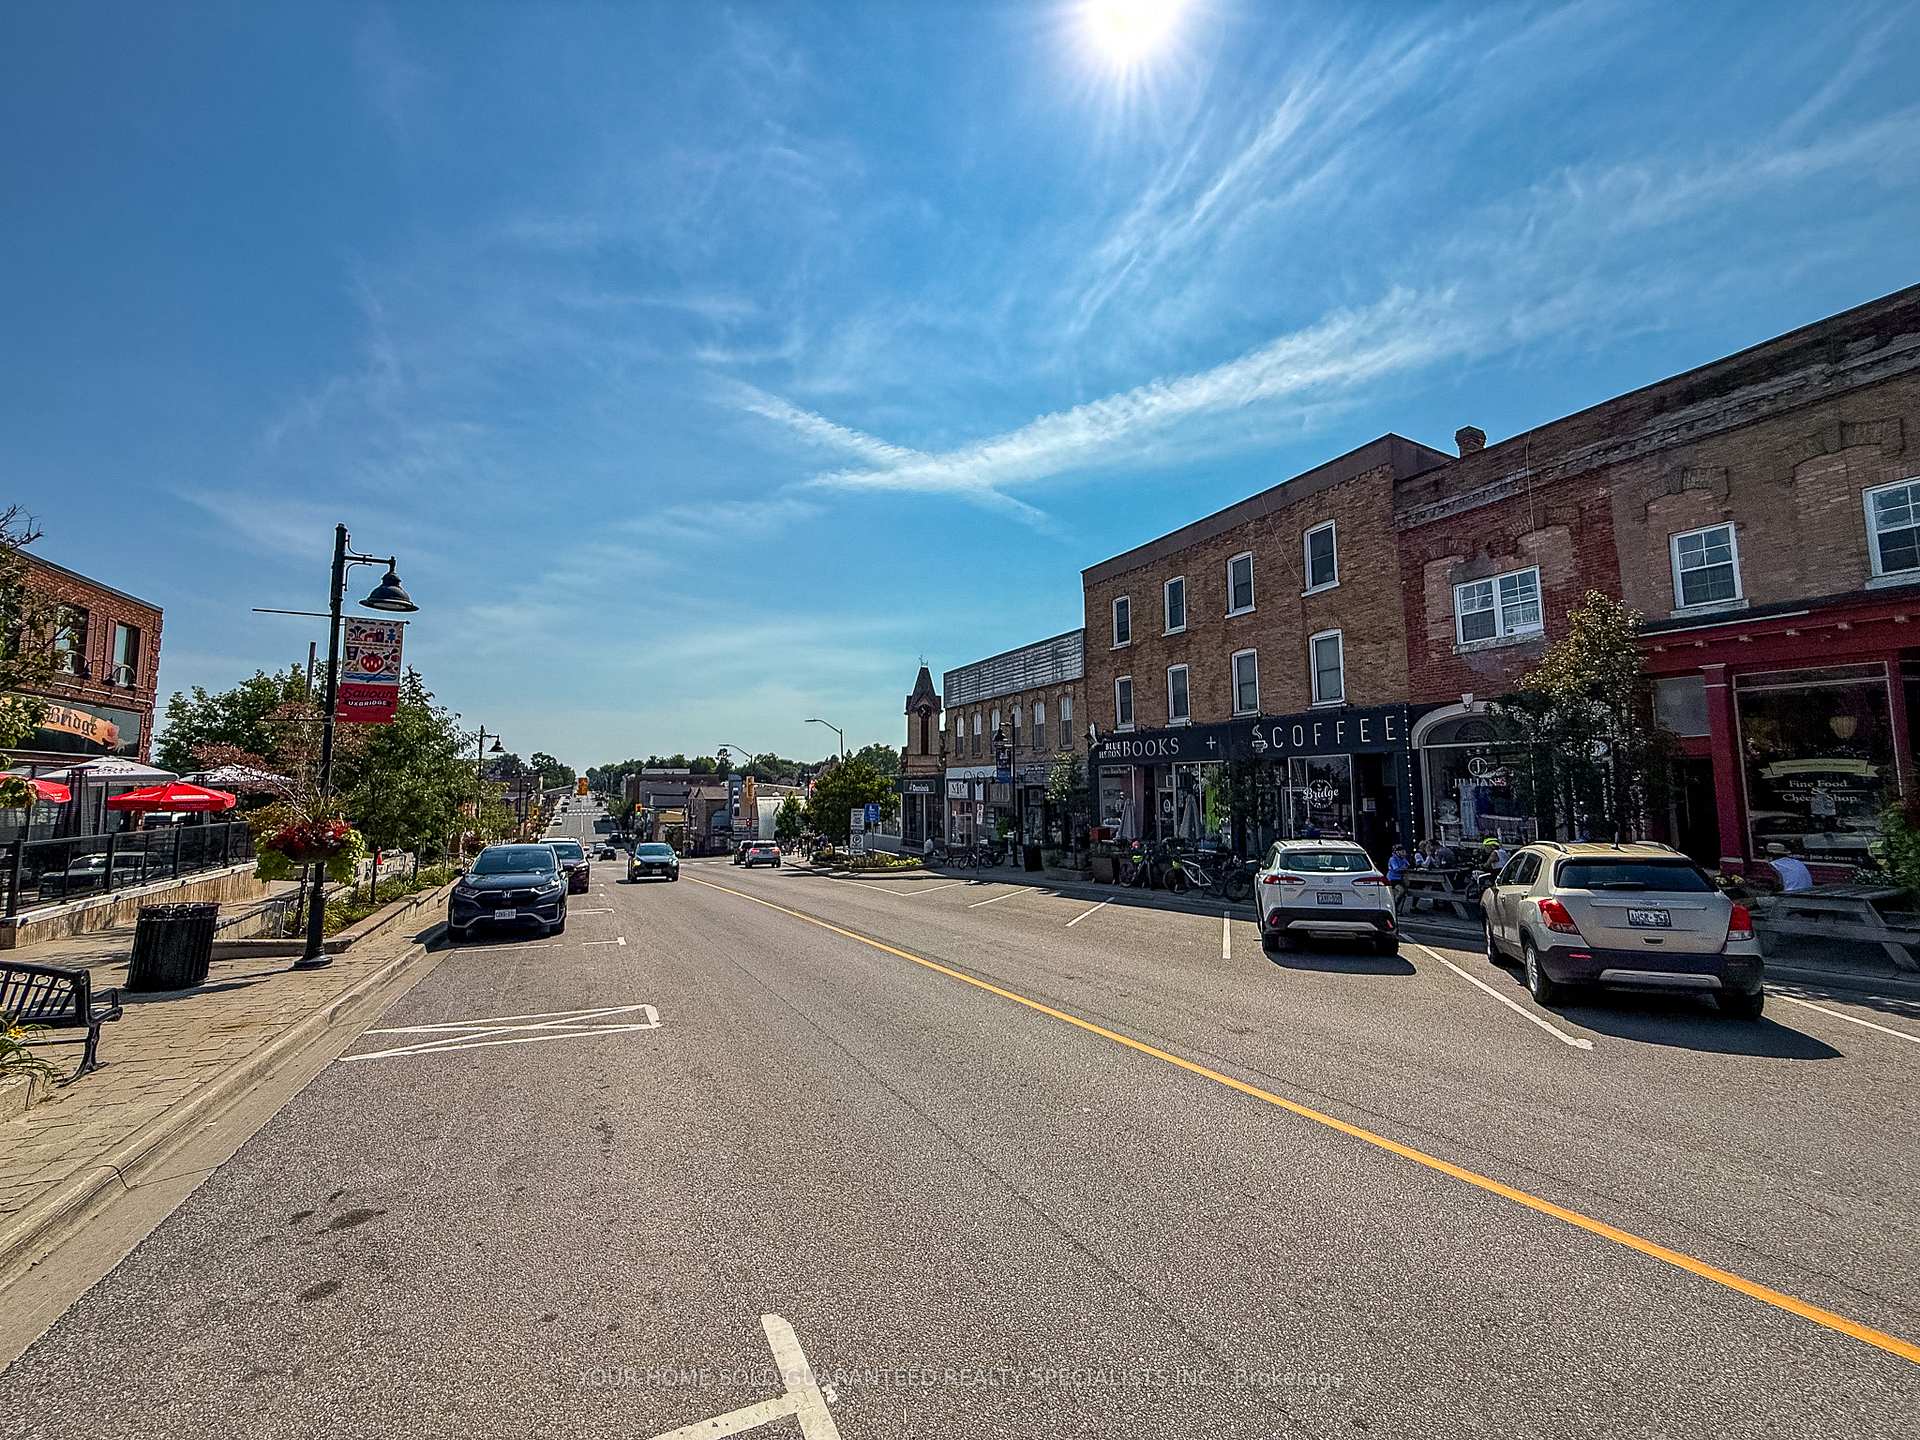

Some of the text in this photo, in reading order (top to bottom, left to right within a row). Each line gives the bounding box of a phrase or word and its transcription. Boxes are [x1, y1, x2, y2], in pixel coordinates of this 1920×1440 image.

[48, 706, 98, 736] Bridge
[1123, 737, 1180, 757] BOOKS
[1272, 715, 1397, 749] COFFEE
[1105, 741, 1122, 750] BLUE
[1789, 780, 1848, 788] Fine Food
[1303, 786, 1339, 801] Bridge
[1825, 793, 1858, 804] Shop
